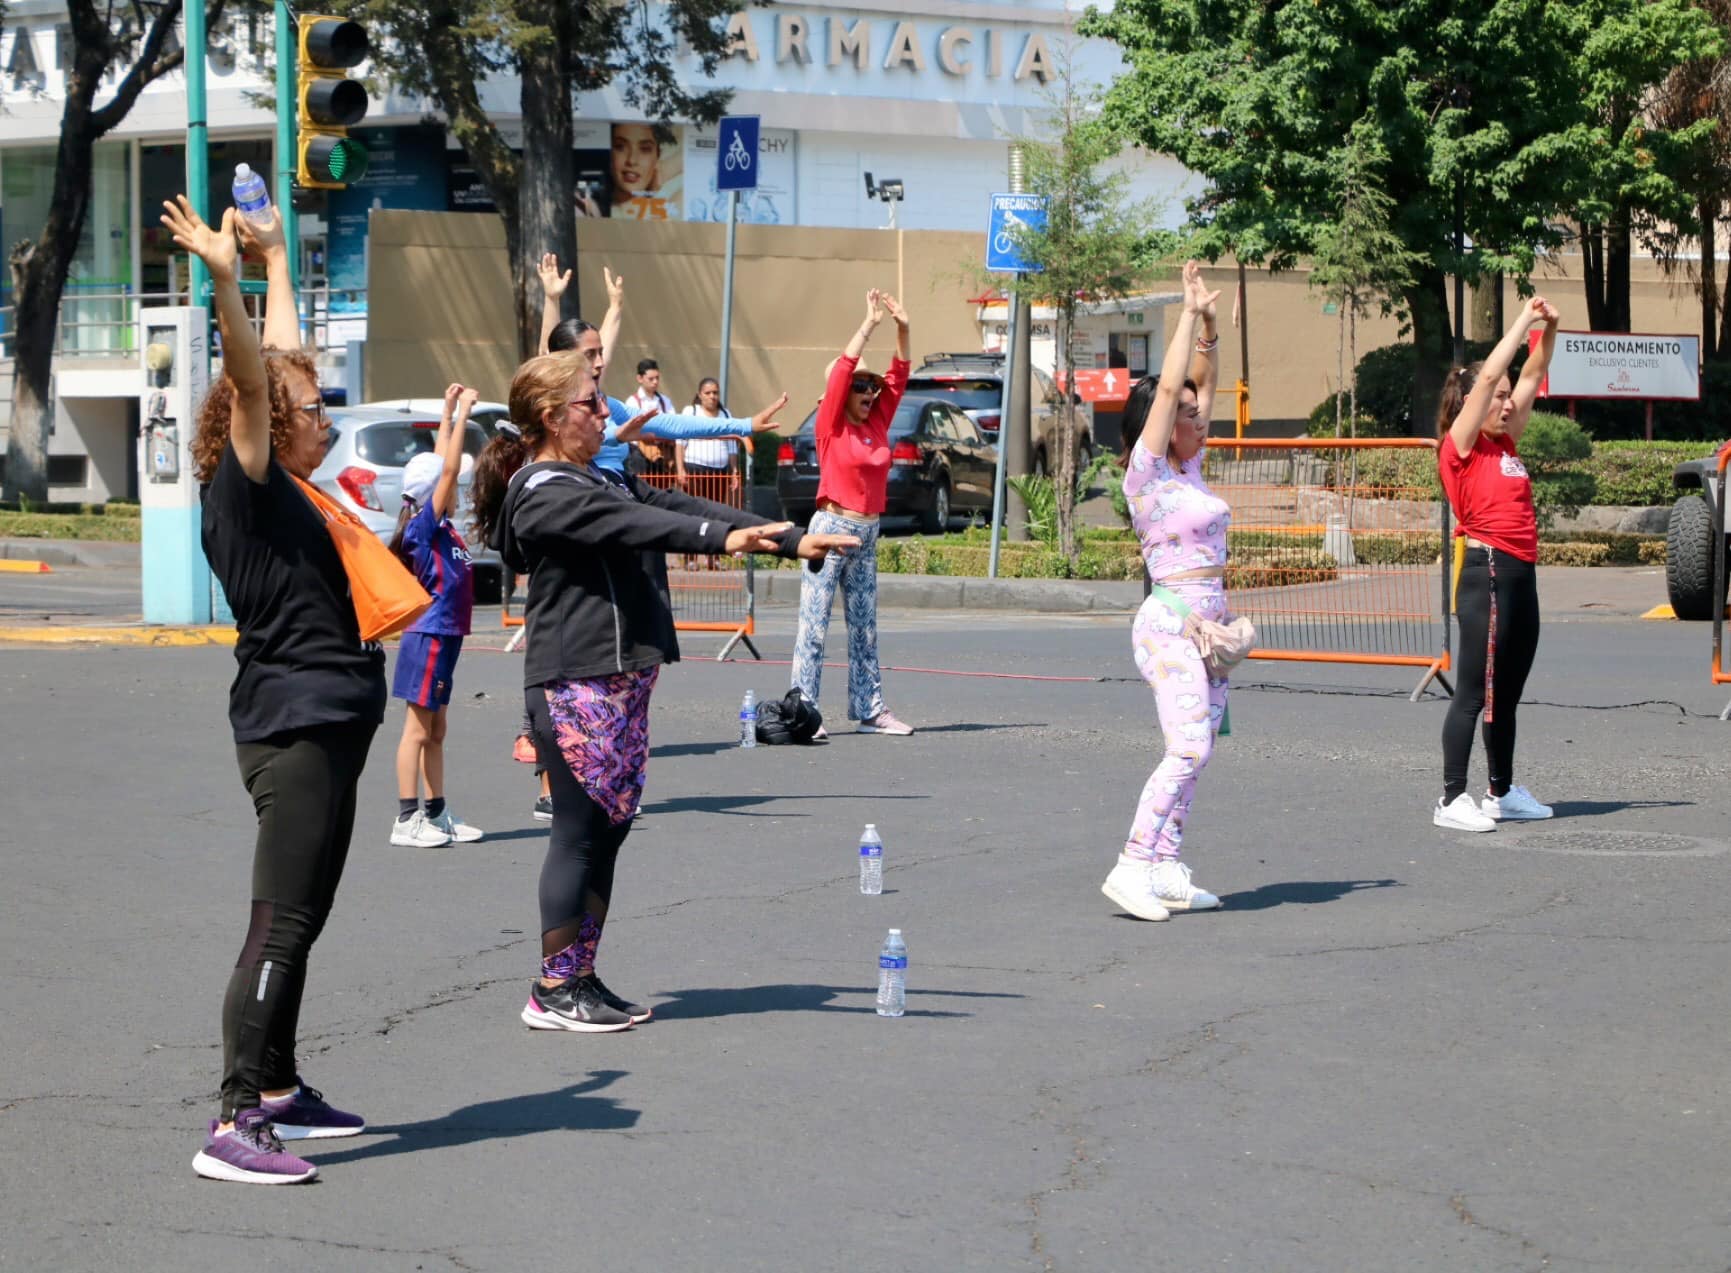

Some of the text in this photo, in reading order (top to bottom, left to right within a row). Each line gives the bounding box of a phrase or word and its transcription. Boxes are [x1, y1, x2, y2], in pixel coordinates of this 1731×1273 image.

[759, 137, 788, 153] CHY
[1566, 339, 1681, 356] ESTACIONAMIENTO
[1589, 357, 1661, 369] EXCLUSIVO CLIENTES
